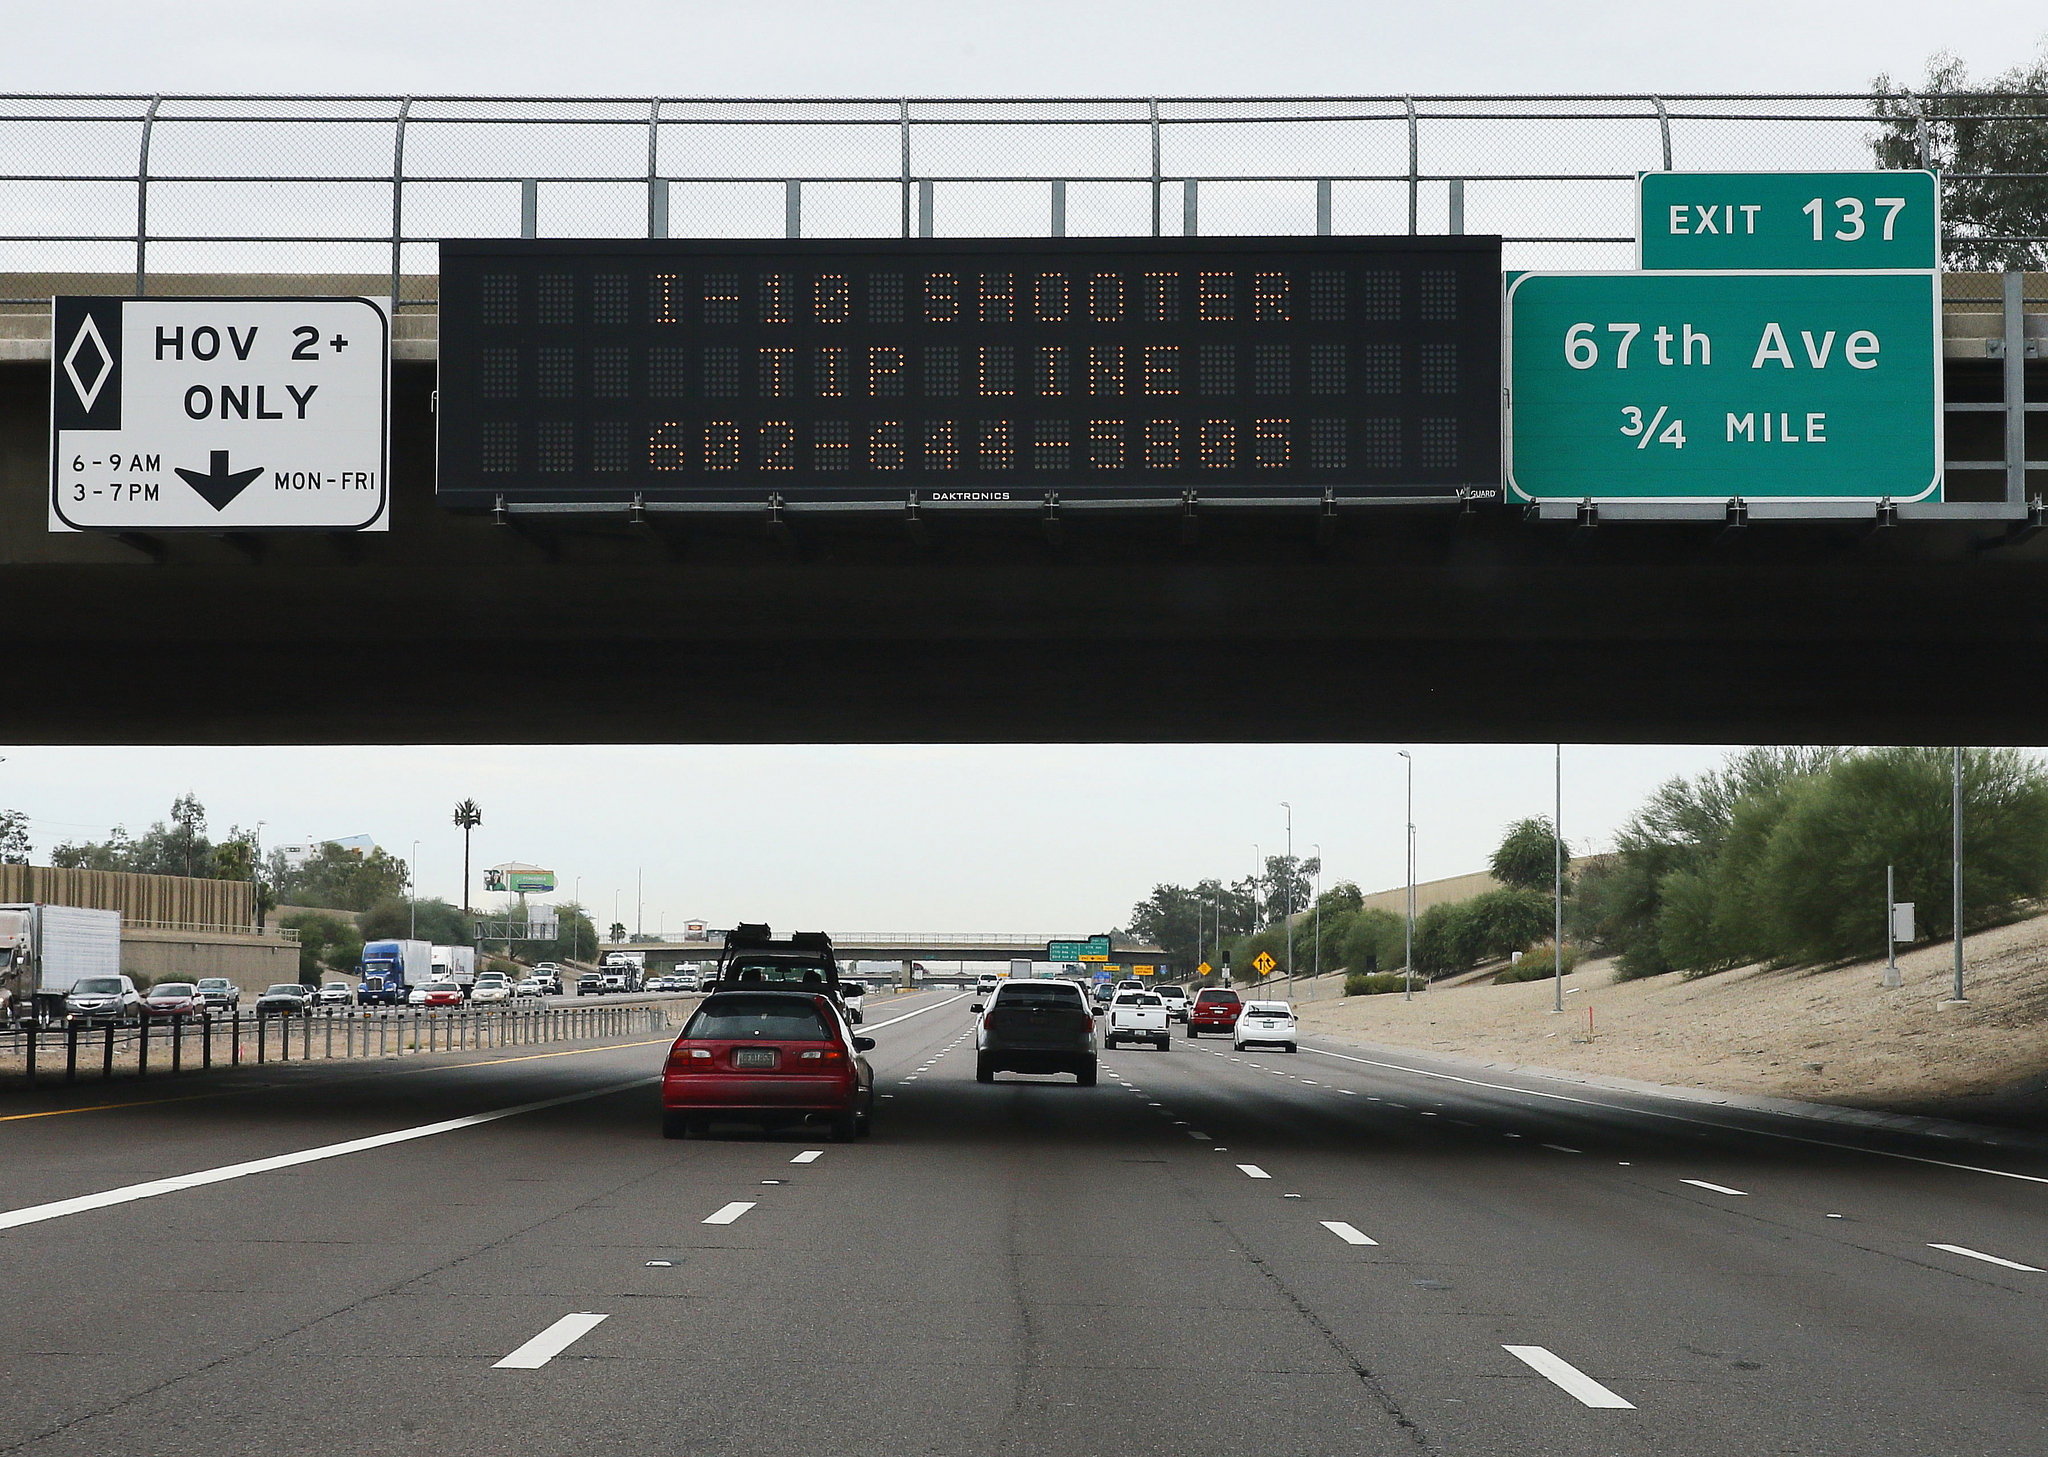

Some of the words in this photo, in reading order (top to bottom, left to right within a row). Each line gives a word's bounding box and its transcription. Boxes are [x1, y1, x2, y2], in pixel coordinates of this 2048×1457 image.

[1669, 205, 1762, 235] EXIT
[1802, 197, 1906, 241] 137
[656, 273, 850, 324] I-10
[924, 272, 1291, 323] SHOOTER
[155, 326, 258, 361] HOV
[291, 326, 349, 361] 2+
[1563, 322, 1711, 370] 67th
[1751, 322, 1881, 370] Ave
[758, 346, 905, 398] TIP
[979, 345, 1181, 396] LINE
[184, 384, 318, 420] ONLY
[649, 418, 1291, 472] 602-644-5805
[1726, 412, 1827, 443] MILE
[129, 454, 161, 472] AM
[129, 484, 160, 501] PM
[932, 492, 1010, 500] DAKTRONICS
[1455, 488, 1496, 498] VGUARD
